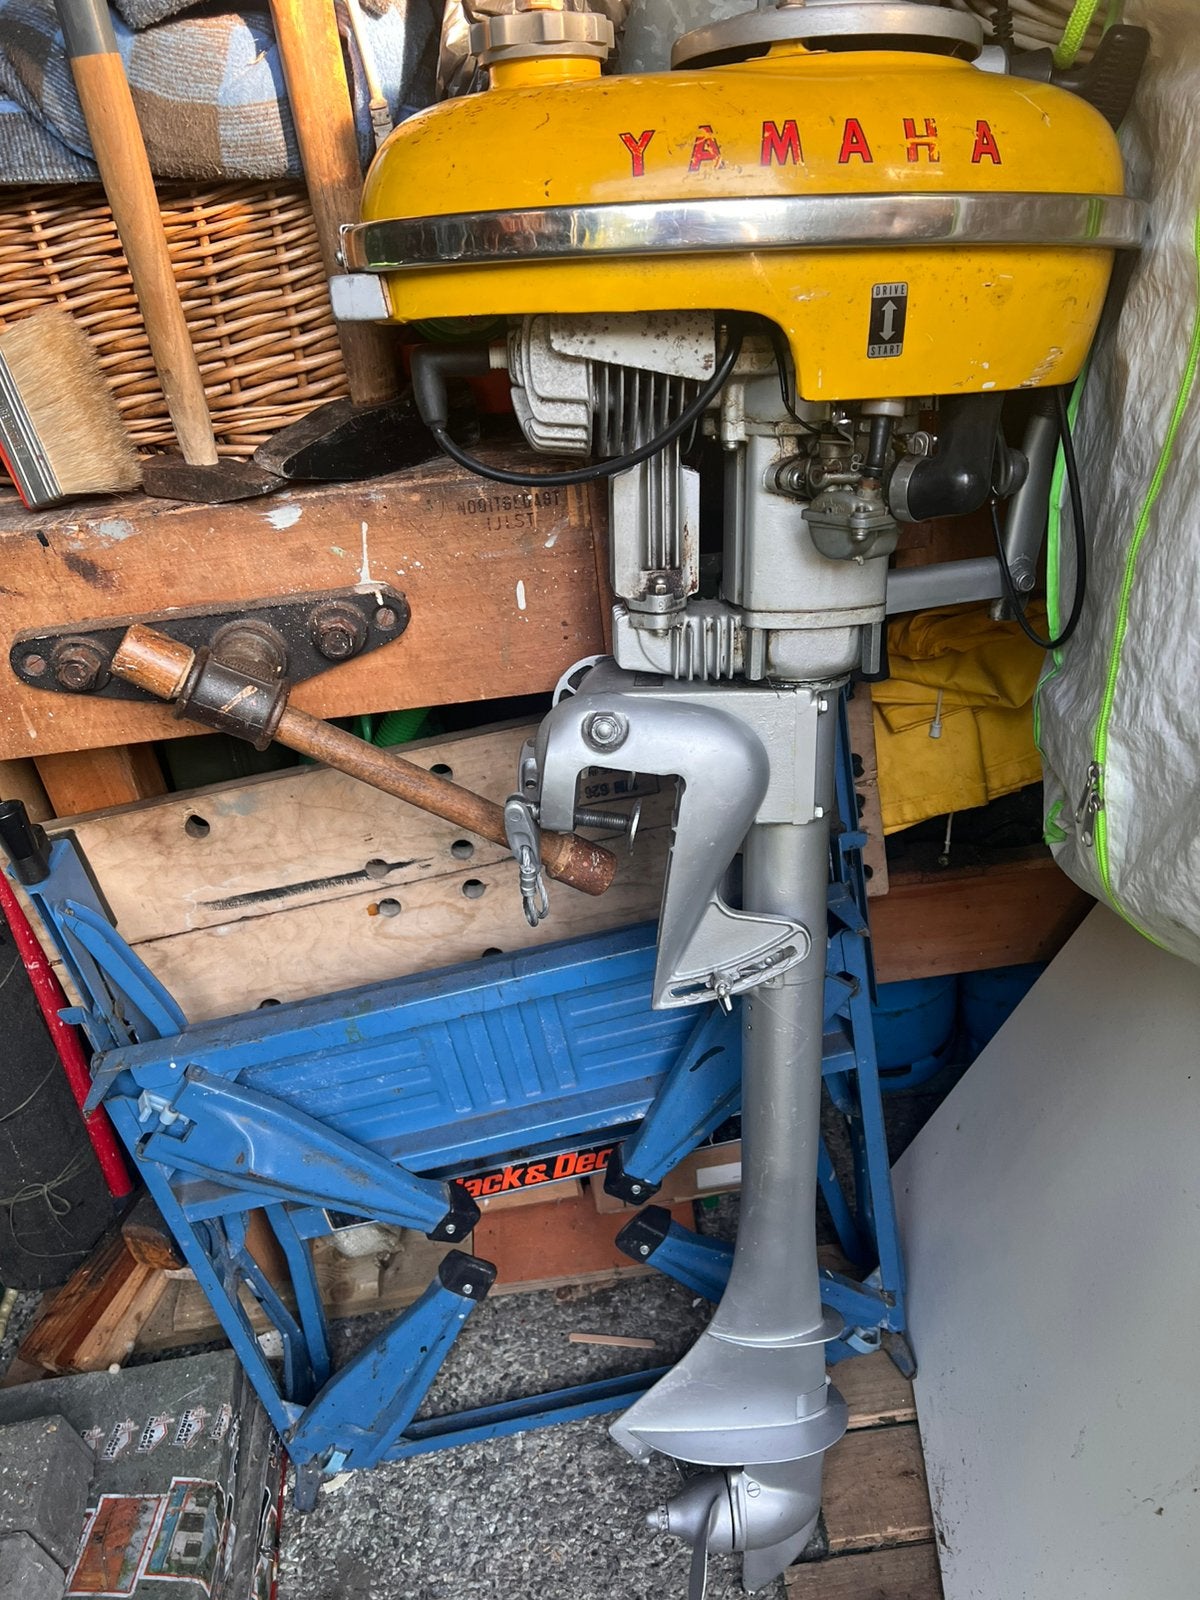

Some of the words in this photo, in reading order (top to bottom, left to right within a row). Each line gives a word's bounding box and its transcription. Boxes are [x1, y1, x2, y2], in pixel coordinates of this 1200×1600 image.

[619, 118, 1002, 177] YAMAHA
[875, 284, 906, 297] DRIVE
[870, 344, 901, 356] START
[455, 1166, 525, 1198] ack
[552, 1148, 614, 1180] Dec
